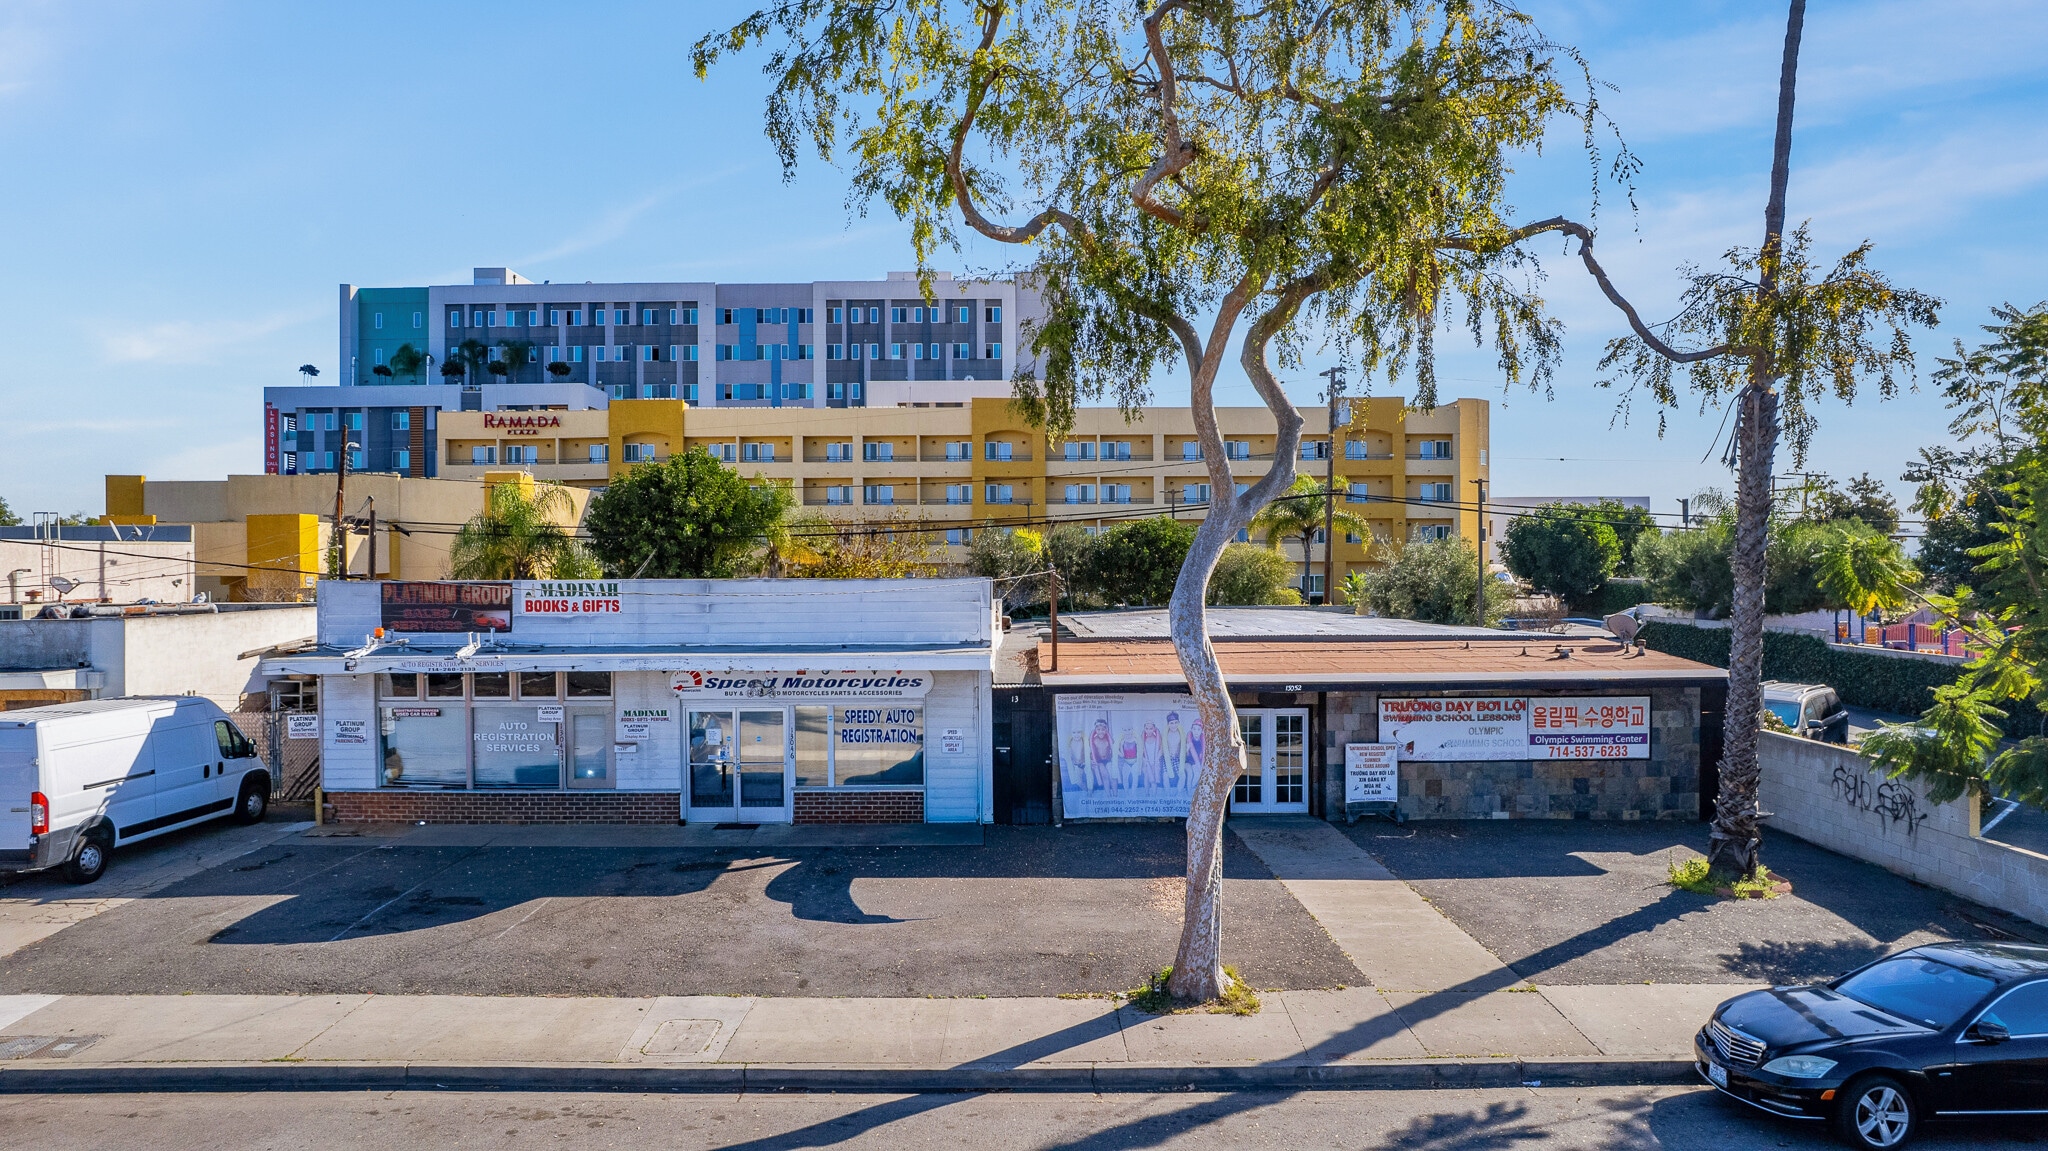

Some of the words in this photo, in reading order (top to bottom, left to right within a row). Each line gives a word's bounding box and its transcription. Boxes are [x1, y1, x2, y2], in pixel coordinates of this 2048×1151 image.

[484, 413, 560, 428] RAMADA
[383, 584, 457, 603] PLATINUM
[462, 586, 511, 605] GROUP
[540, 582, 618, 598] MADINAH
[525, 600, 569, 613] BOOKS
[572, 602, 579, 613] &
[583, 600, 620, 613] GIFTS
[475, 660, 504, 668] SERVICES
[705, 677, 778, 689] Speed
[782, 677, 923, 689] Motorcycles
[1011, 695, 1018, 703] 13
[1446, 700, 1474, 714] DẠY
[1477, 700, 1501, 712] BƠI
[1505, 698, 1527, 714] LỘI
[623, 709, 667, 717] MADINAH
[845, 709, 882, 724] SPEEDY
[885, 709, 915, 724] AUTO
[1383, 714, 1433, 722] SWIMMING
[1435, 713, 1475, 722] SCHOOL
[1478, 713, 1522, 721] LESSONS
[1533, 706, 1578, 728] 올림픽
[1585, 706, 1644, 728] 수영학교
[499, 722, 527, 730] AUTO
[1468, 726, 1504, 736] OLYMPIC
[474, 733, 555, 742] REGISTRATION
[841, 728, 917, 743] REGISTRATION
[1535, 735, 1569, 746] Olympic
[1571, 735, 1614, 745] Swimming
[1615, 735, 1642, 744] Center
[487, 743, 540, 752] SERVICES
[1492, 739, 1525, 748] SCHOOL
[1549, 745, 1629, 758] 714-537-6233
[1095, 806, 1110, 814] (714)
